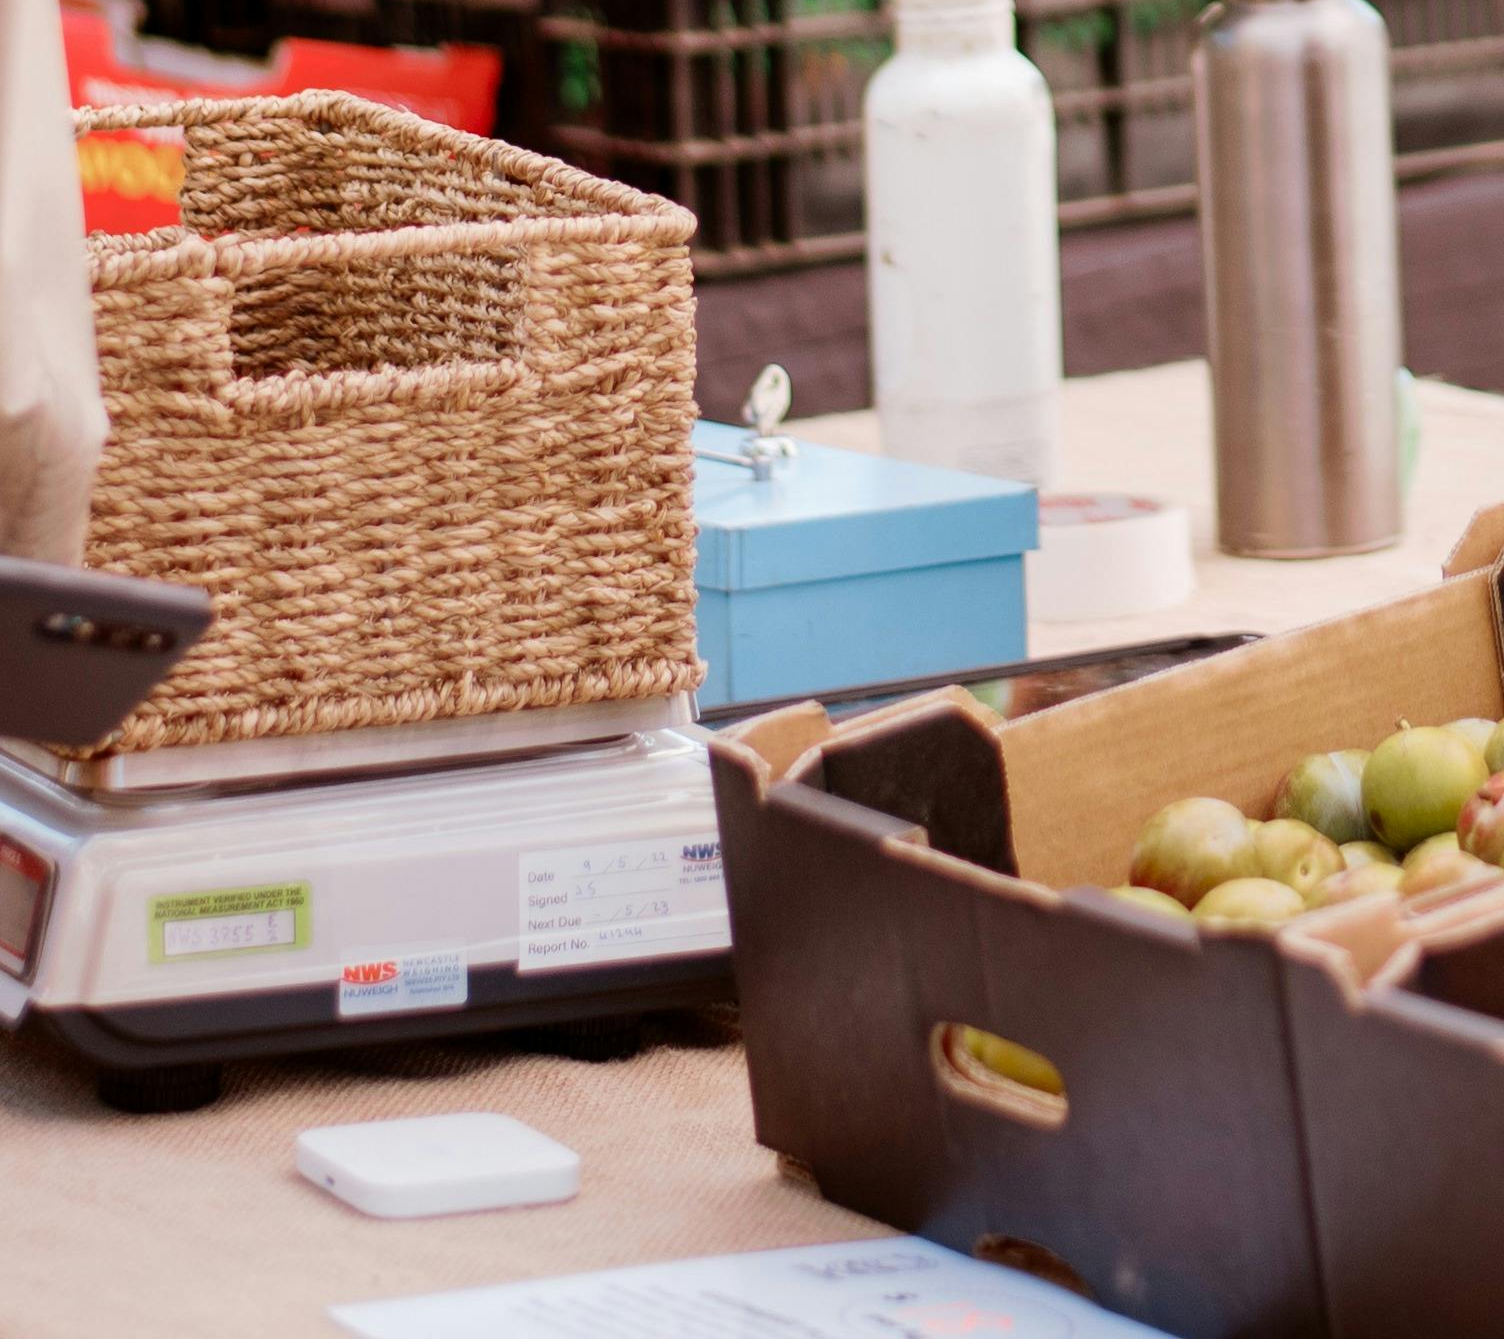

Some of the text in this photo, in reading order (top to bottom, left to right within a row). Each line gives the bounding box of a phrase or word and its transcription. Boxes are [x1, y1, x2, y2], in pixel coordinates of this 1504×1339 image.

[527, 871, 555, 884] Date
[156, 886, 302, 909] INSTRUMENT VERIFIED UNDER THE
[527, 893, 568, 908] Signed
[154, 906, 196, 919] NATIONAL
[199, 900, 265, 915] MEASUREMENT
[266, 897, 284, 908] ACT
[527, 917, 554, 931] Next
[558, 915, 582, 928] Due
[527, 942, 567, 956] Report
[570, 939, 591, 950] No.
[343, 961, 398, 981] NWS
[344, 984, 398, 998] NUWEIGH
